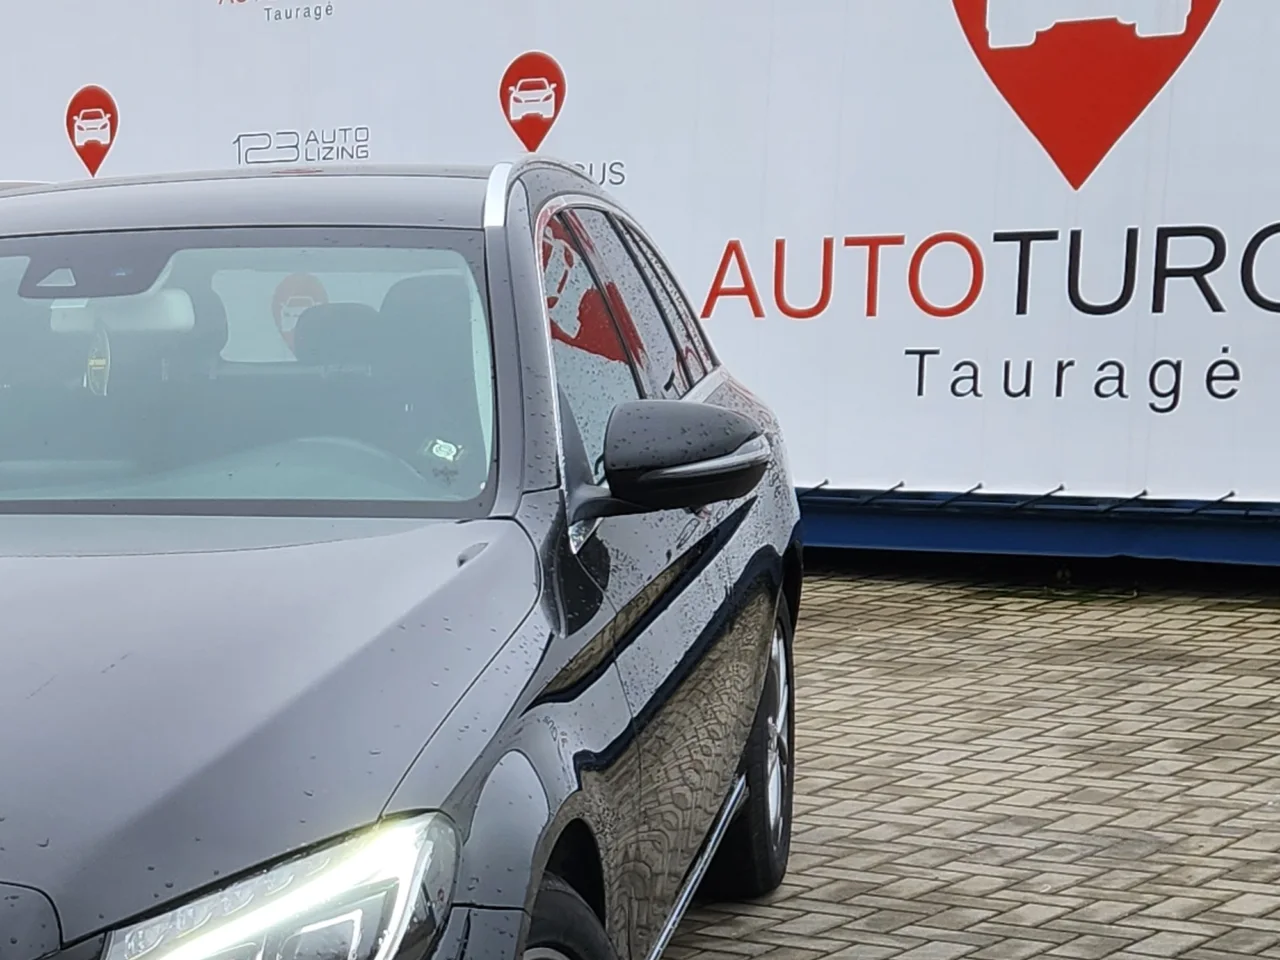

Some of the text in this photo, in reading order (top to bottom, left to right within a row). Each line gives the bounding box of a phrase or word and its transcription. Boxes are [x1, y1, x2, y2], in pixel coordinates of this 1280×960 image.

[264, 1, 333, 21] Tauragė
[232, 126, 370, 165] 123 AUTO
[304, 145, 370, 162] LIZING
[903, 345, 1242, 415] Tauragė
